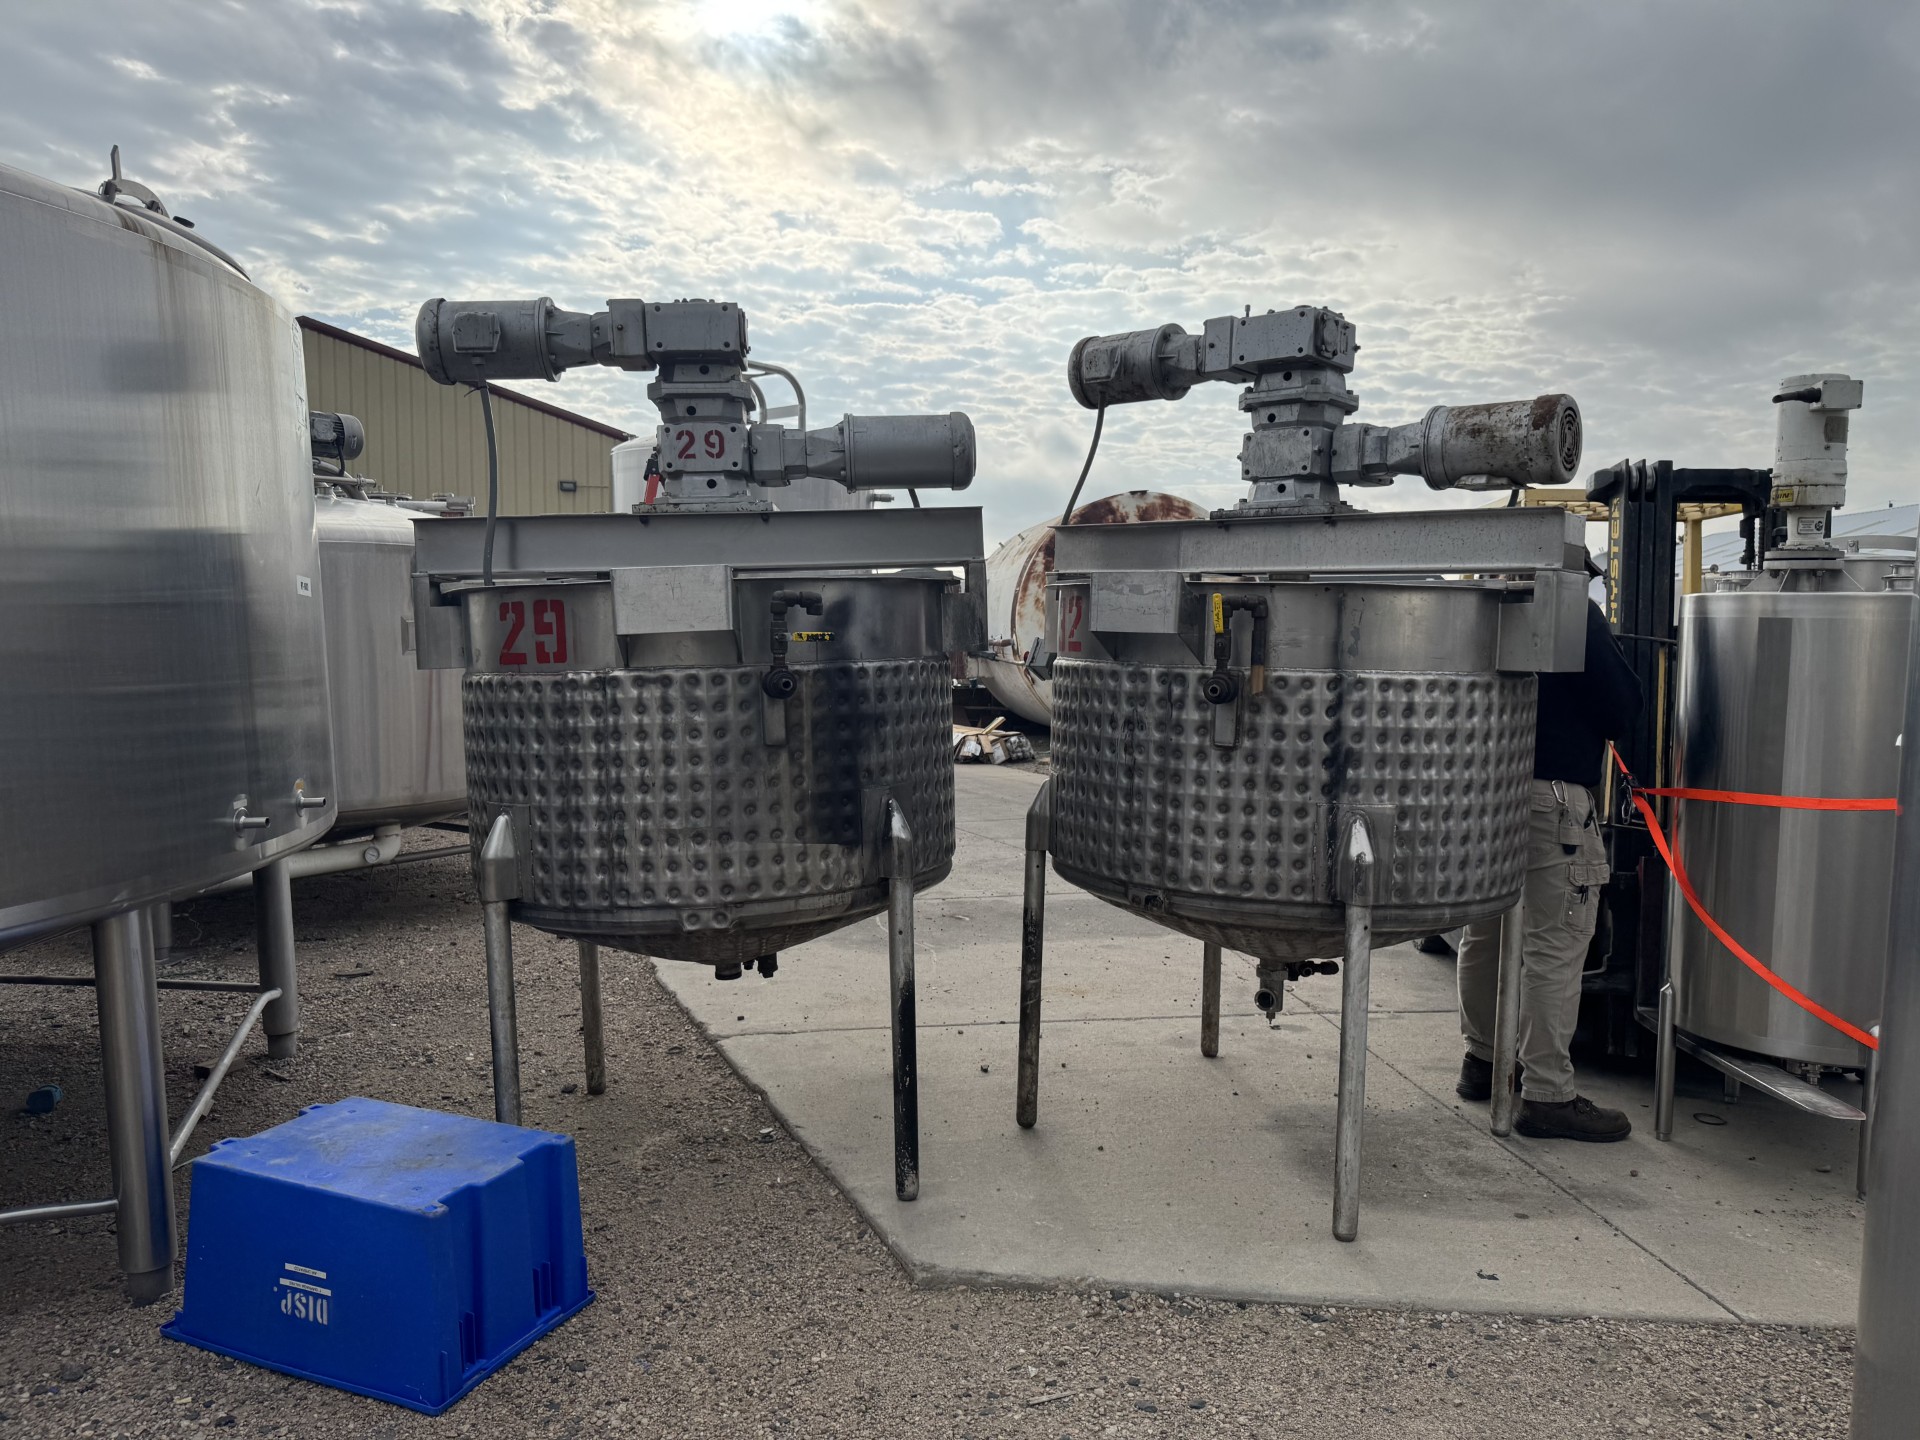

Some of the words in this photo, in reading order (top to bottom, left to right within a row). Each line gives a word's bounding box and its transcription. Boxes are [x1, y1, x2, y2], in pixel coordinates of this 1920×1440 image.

[675, 430, 725, 459] 29
[1610, 497, 1620, 624] HYSTER
[499, 599, 567, 665] 29
